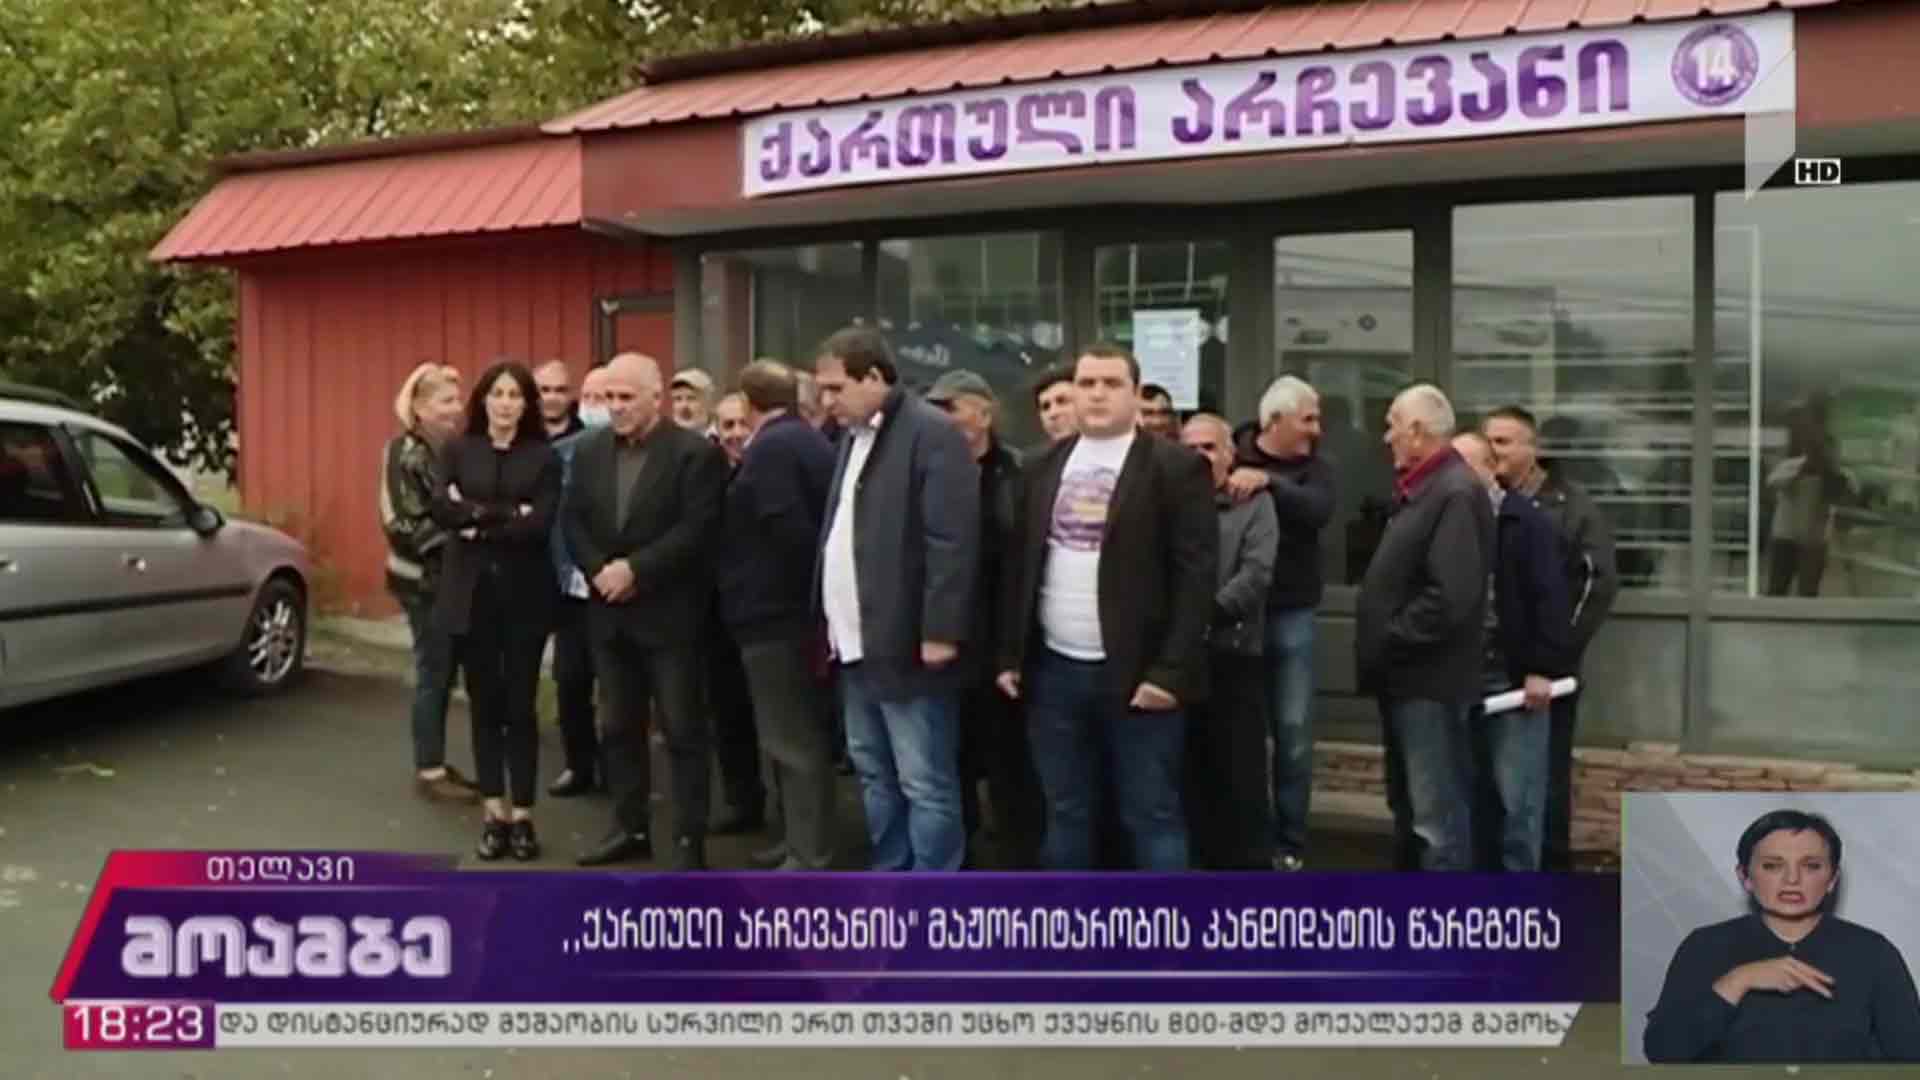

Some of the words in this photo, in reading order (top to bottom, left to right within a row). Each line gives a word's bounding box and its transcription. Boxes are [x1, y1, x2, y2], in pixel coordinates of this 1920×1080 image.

[759, 84, 1138, 182] ქართული
[1171, 38, 1631, 145] არჩევანი
[1690, 35, 1740, 89] 14
